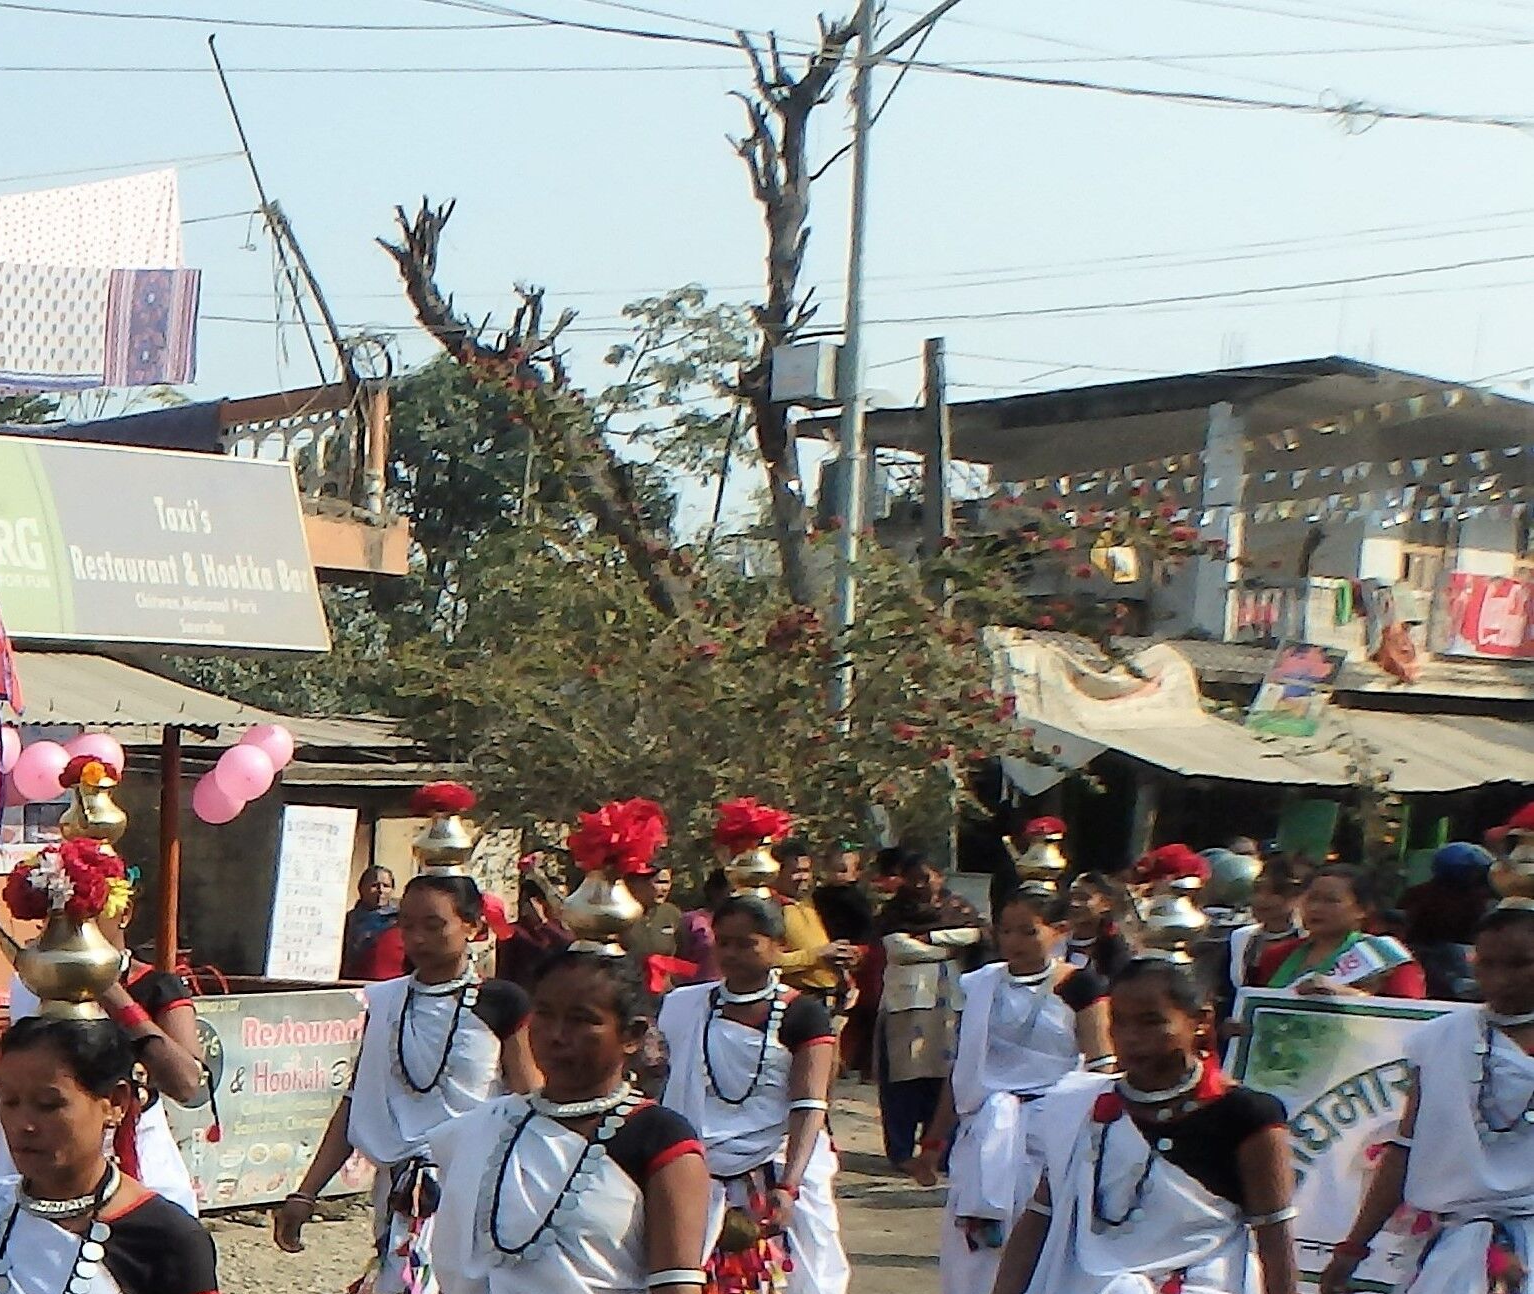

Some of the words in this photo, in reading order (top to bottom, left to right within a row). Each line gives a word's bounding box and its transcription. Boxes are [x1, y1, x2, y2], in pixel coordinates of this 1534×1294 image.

[153, 496, 212, 534] Taxi's
[69, 545, 179, 585] Restaurant
[182, 552, 199, 587] &
[276, 559, 312, 592] Bar
